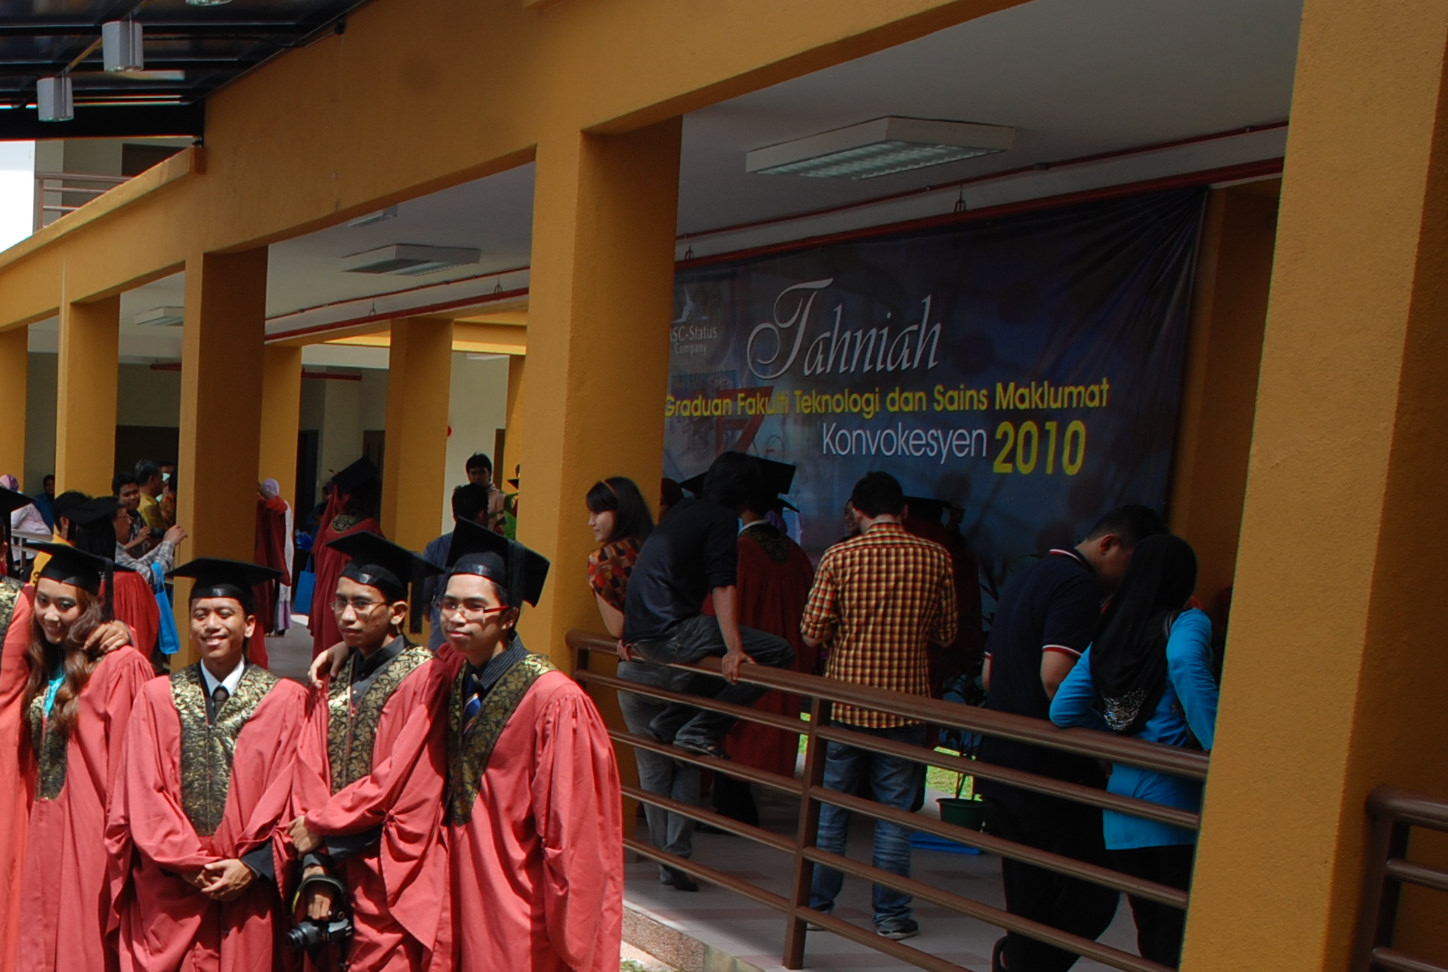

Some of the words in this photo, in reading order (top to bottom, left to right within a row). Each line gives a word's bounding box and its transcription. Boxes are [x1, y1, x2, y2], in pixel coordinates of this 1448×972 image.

[670, 324, 718, 343] SC-Status
[747, 277, 942, 380] Tahniah
[664, 388, 733, 416] Graduan
[793, 385, 880, 420] Teknologi
[886, 386, 928, 412] dan
[934, 383, 988, 411] Sains
[995, 377, 1111, 410] Maklumat
[822, 422, 987, 464] Konvokesyen
[993, 420, 1087, 477] 2010
